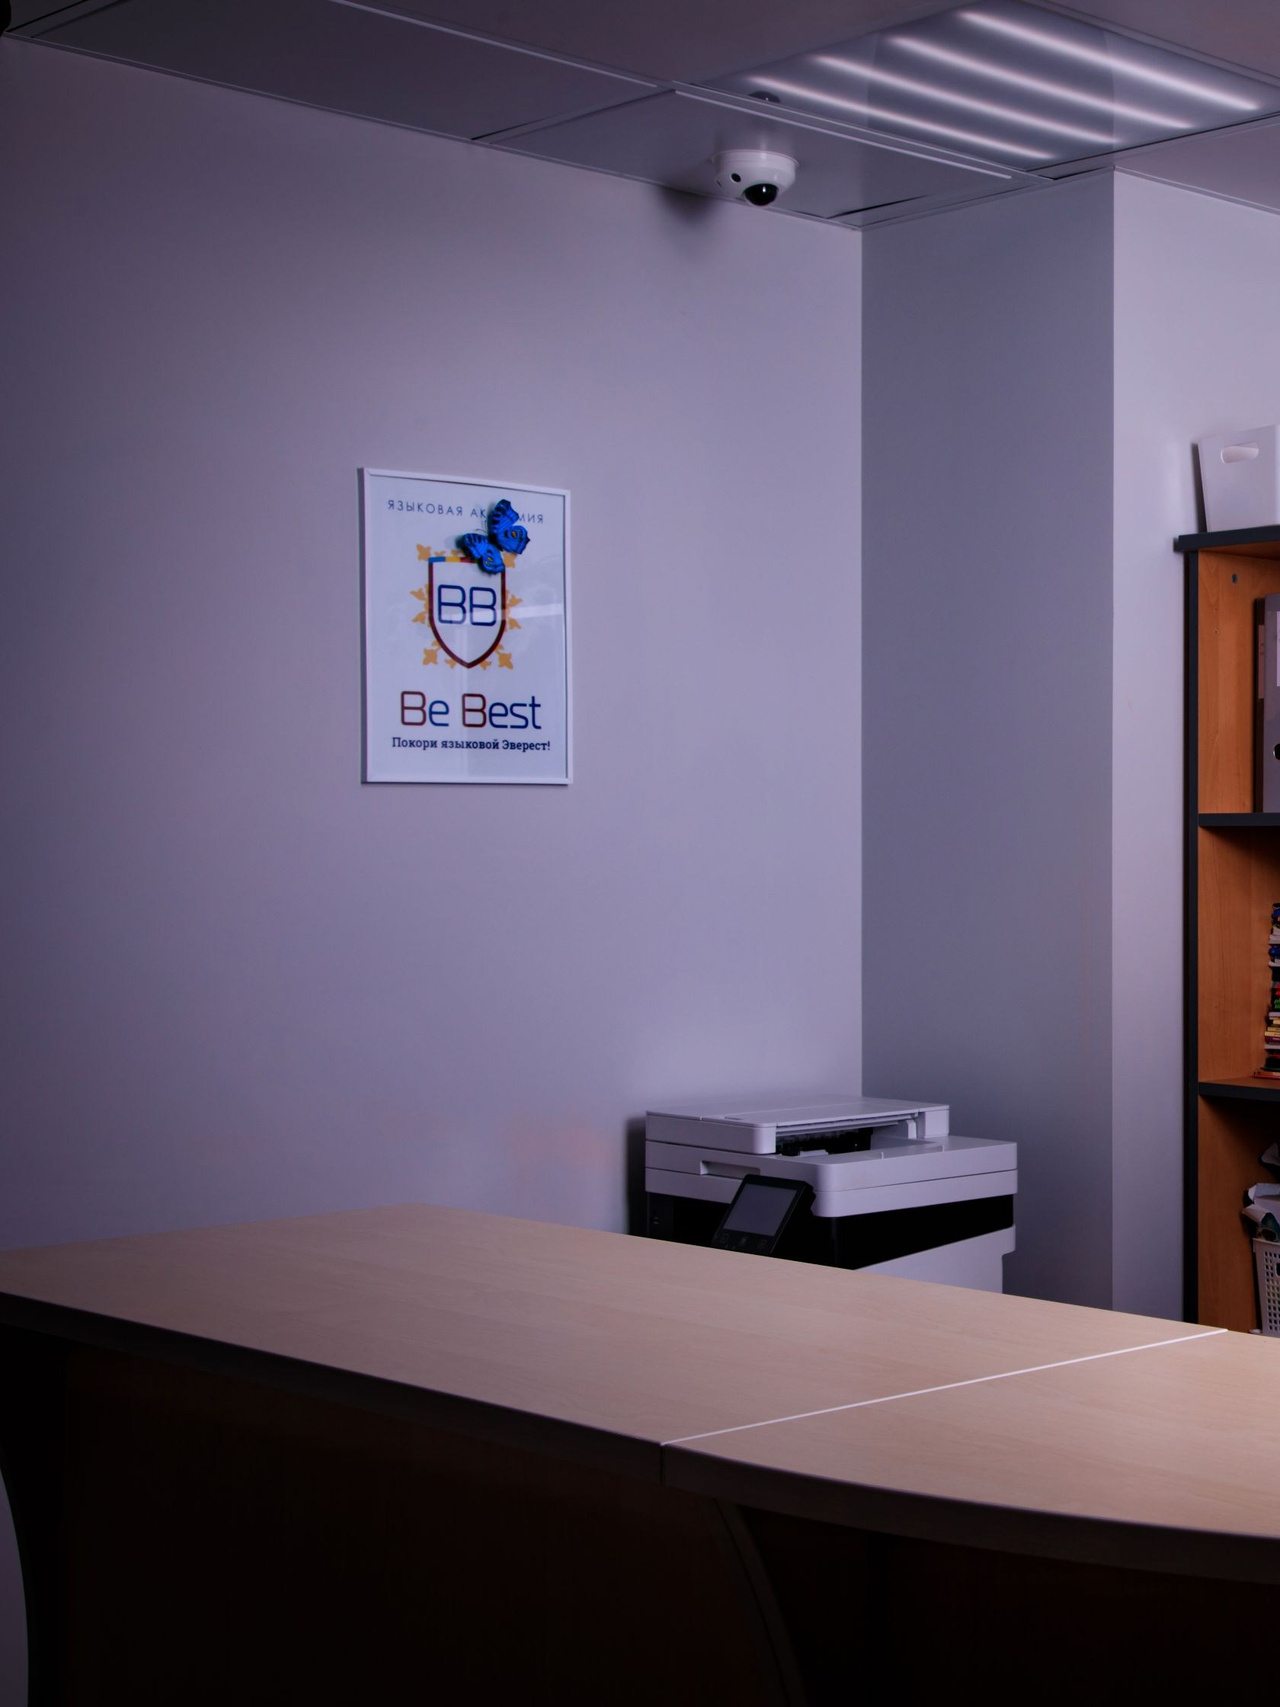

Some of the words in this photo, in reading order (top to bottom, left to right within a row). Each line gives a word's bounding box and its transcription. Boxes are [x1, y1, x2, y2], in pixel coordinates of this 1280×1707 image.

[388, 499, 463, 517] ЯЗЫКОВАЯ
[470, 507, 544, 524] АКМИЯ
[437, 584, 497, 627] BB
[400, 690, 450, 727] Be
[461, 692, 542, 730] Best
[392, 736, 438, 751] Покори
[440, 739, 500, 750] языковой
[501, 739, 551, 753] Эверест!
